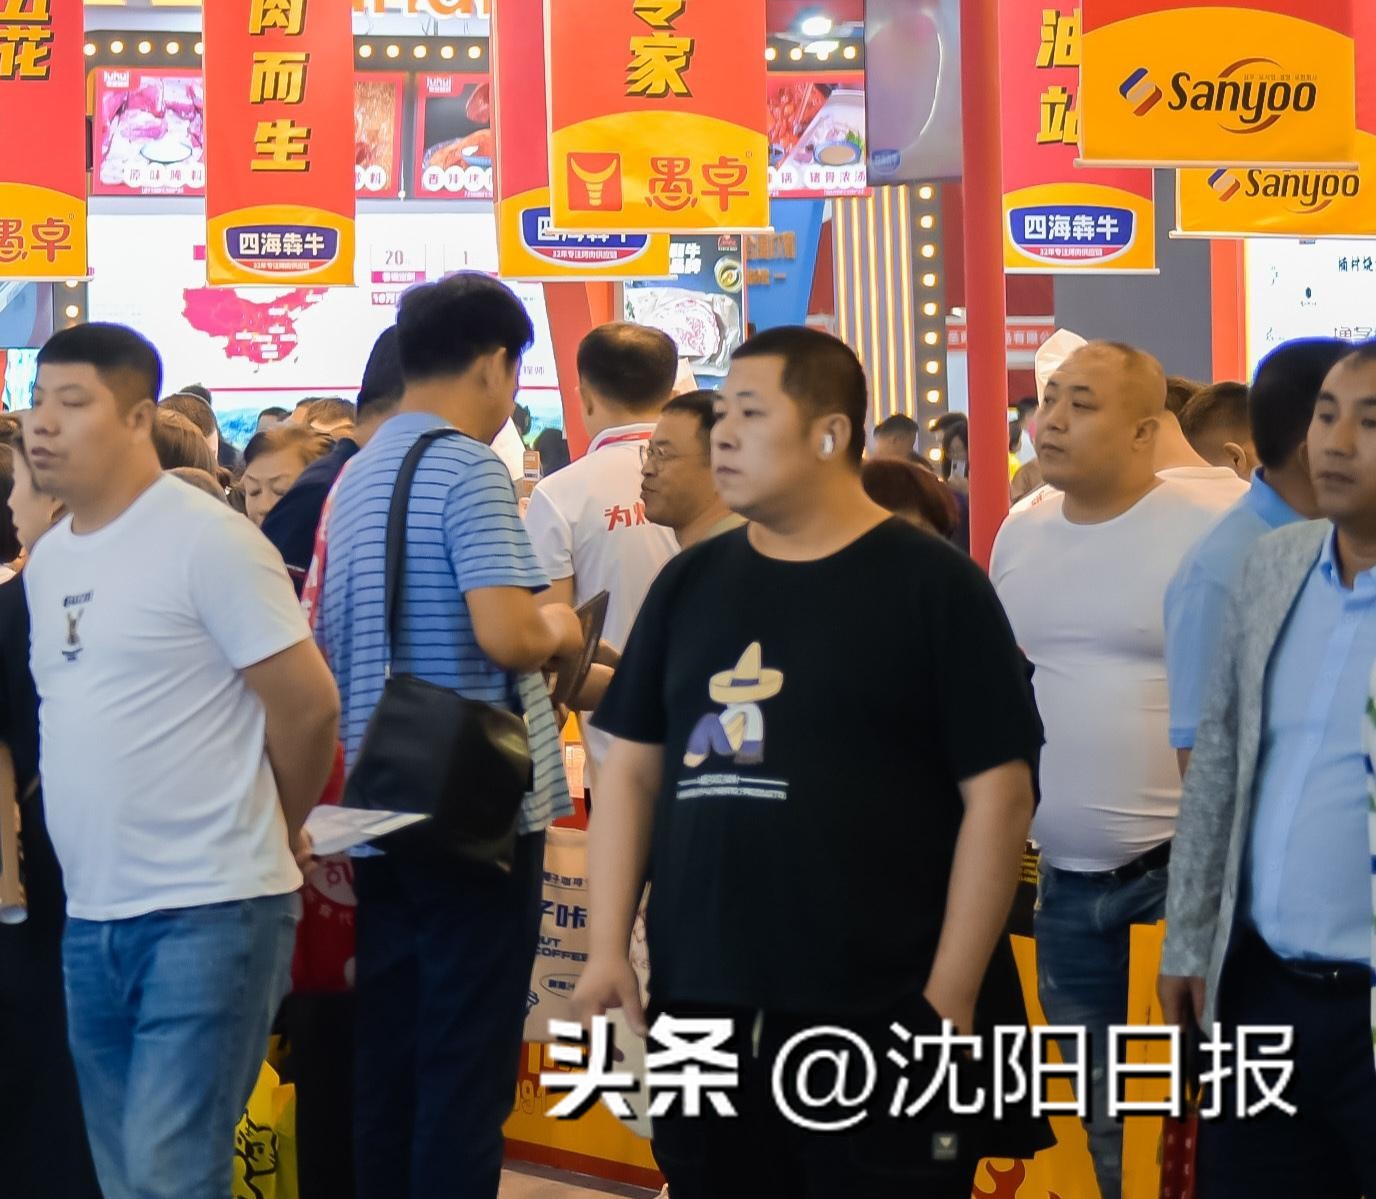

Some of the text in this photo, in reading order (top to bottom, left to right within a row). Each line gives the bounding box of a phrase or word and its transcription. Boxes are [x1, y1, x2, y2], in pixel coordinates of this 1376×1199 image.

[1167, 71, 1317, 124] Sanyoo
[646, 155, 750, 212] 愚卓
[1245, 168, 1360, 207] Sanyoo
[238, 231, 326, 256] 四海犇牛
[1023, 214, 1119, 242] 四海犇牛
